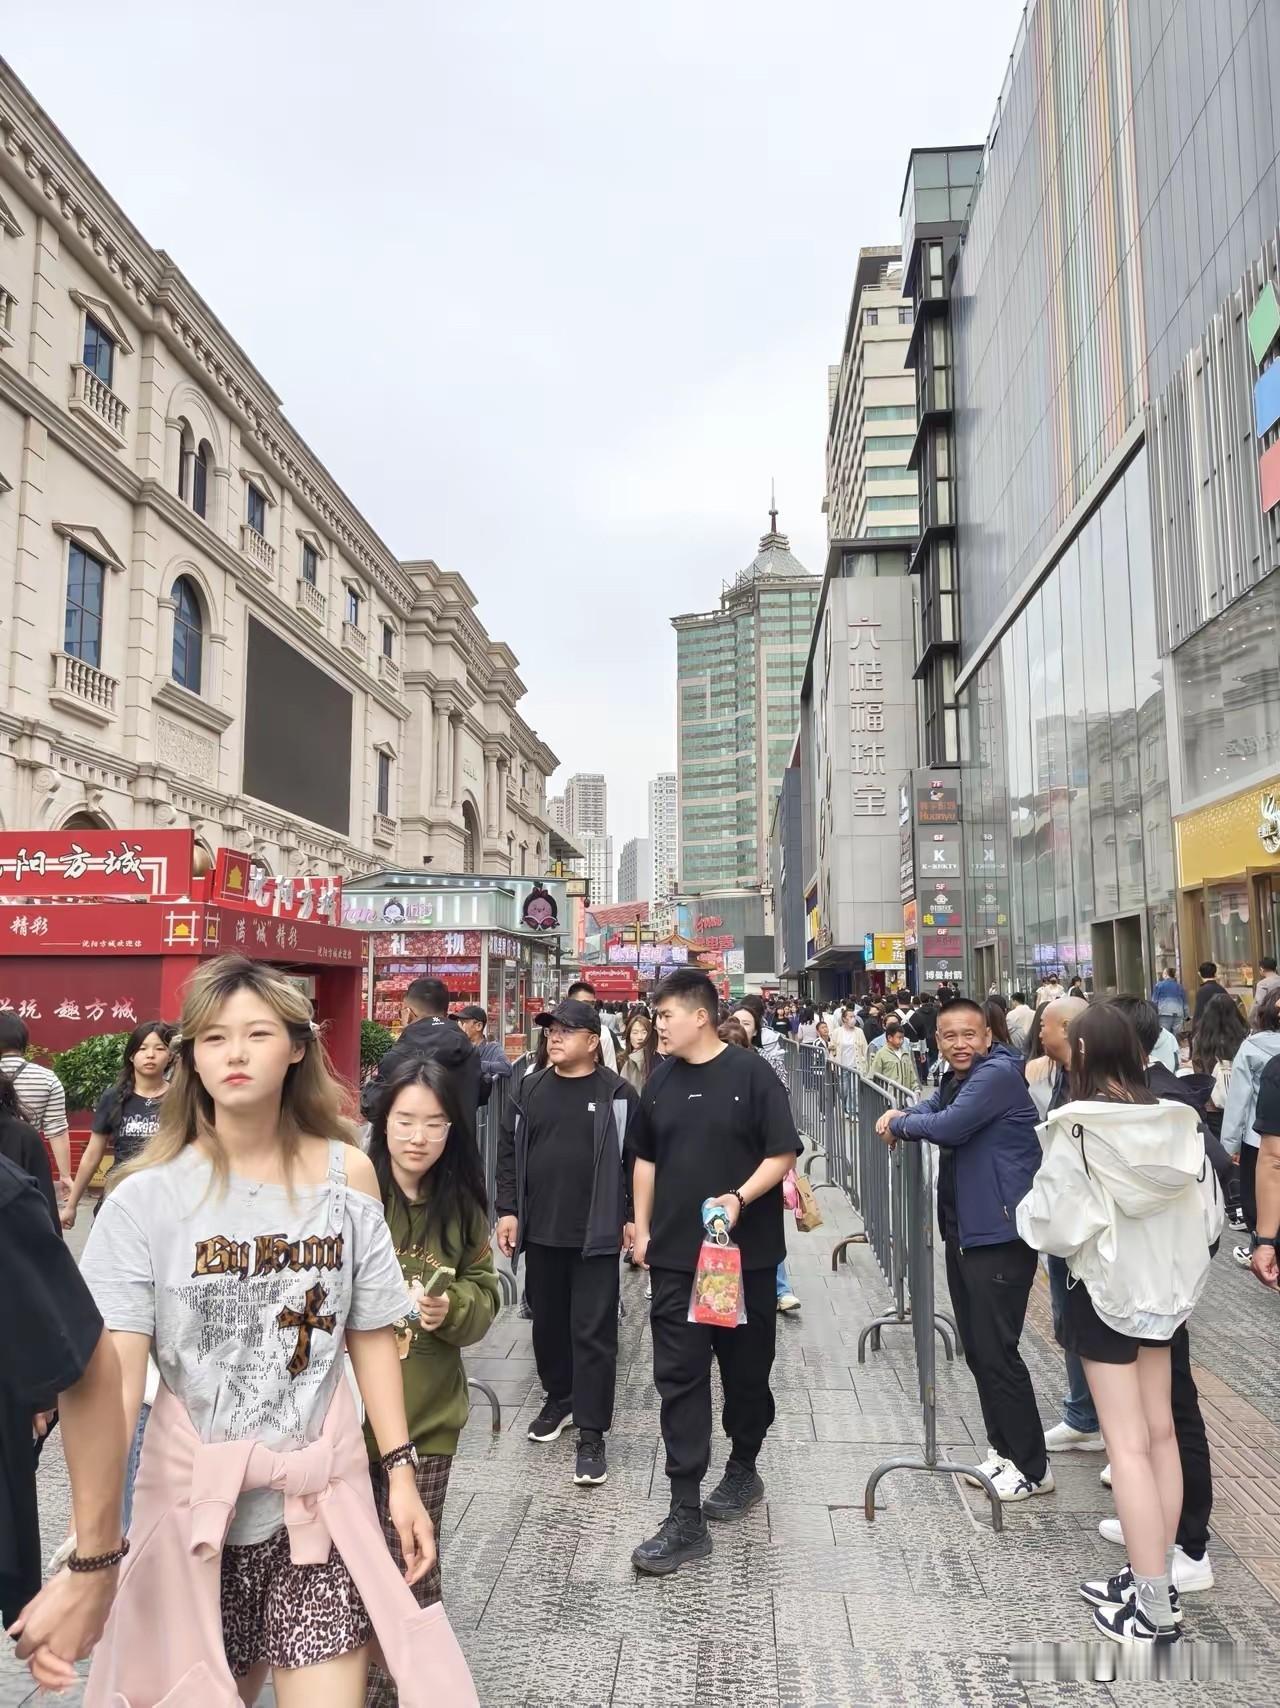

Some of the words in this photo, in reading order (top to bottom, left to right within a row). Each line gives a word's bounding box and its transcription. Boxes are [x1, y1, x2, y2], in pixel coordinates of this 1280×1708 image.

[0, 842, 145, 882] 阳方城
[934, 849, 945, 862] K
[10, 915, 48, 937] 精彩
[54, 996, 138, 1024] 趣方城
